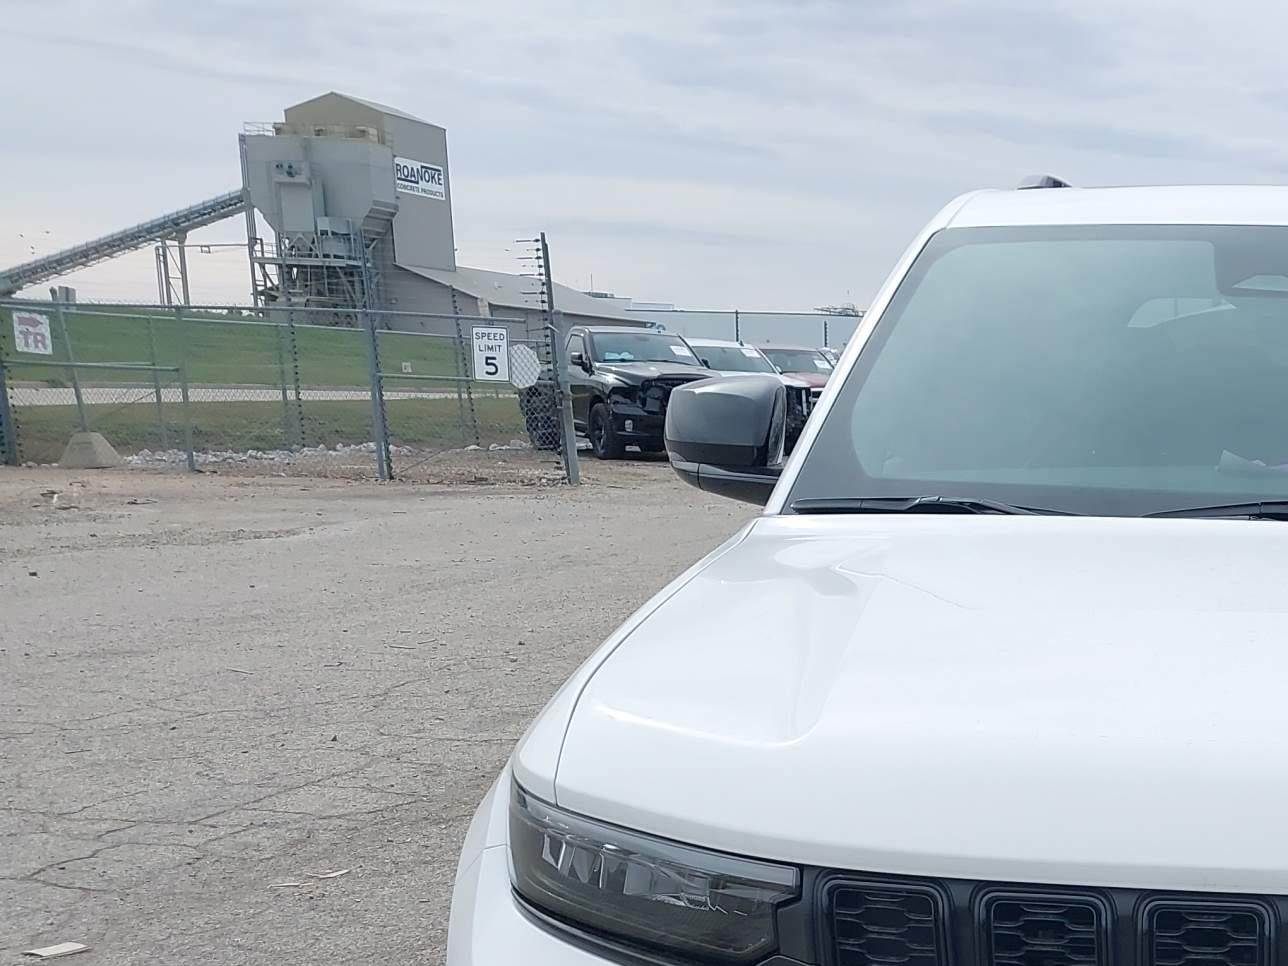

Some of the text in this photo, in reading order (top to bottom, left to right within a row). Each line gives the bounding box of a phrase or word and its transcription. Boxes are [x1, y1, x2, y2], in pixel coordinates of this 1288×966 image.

[396, 163, 443, 186] ROANOKE
[474, 332, 505, 341] SPEED
[478, 344, 502, 353] LIMIT
[484, 356, 499, 376] 5
